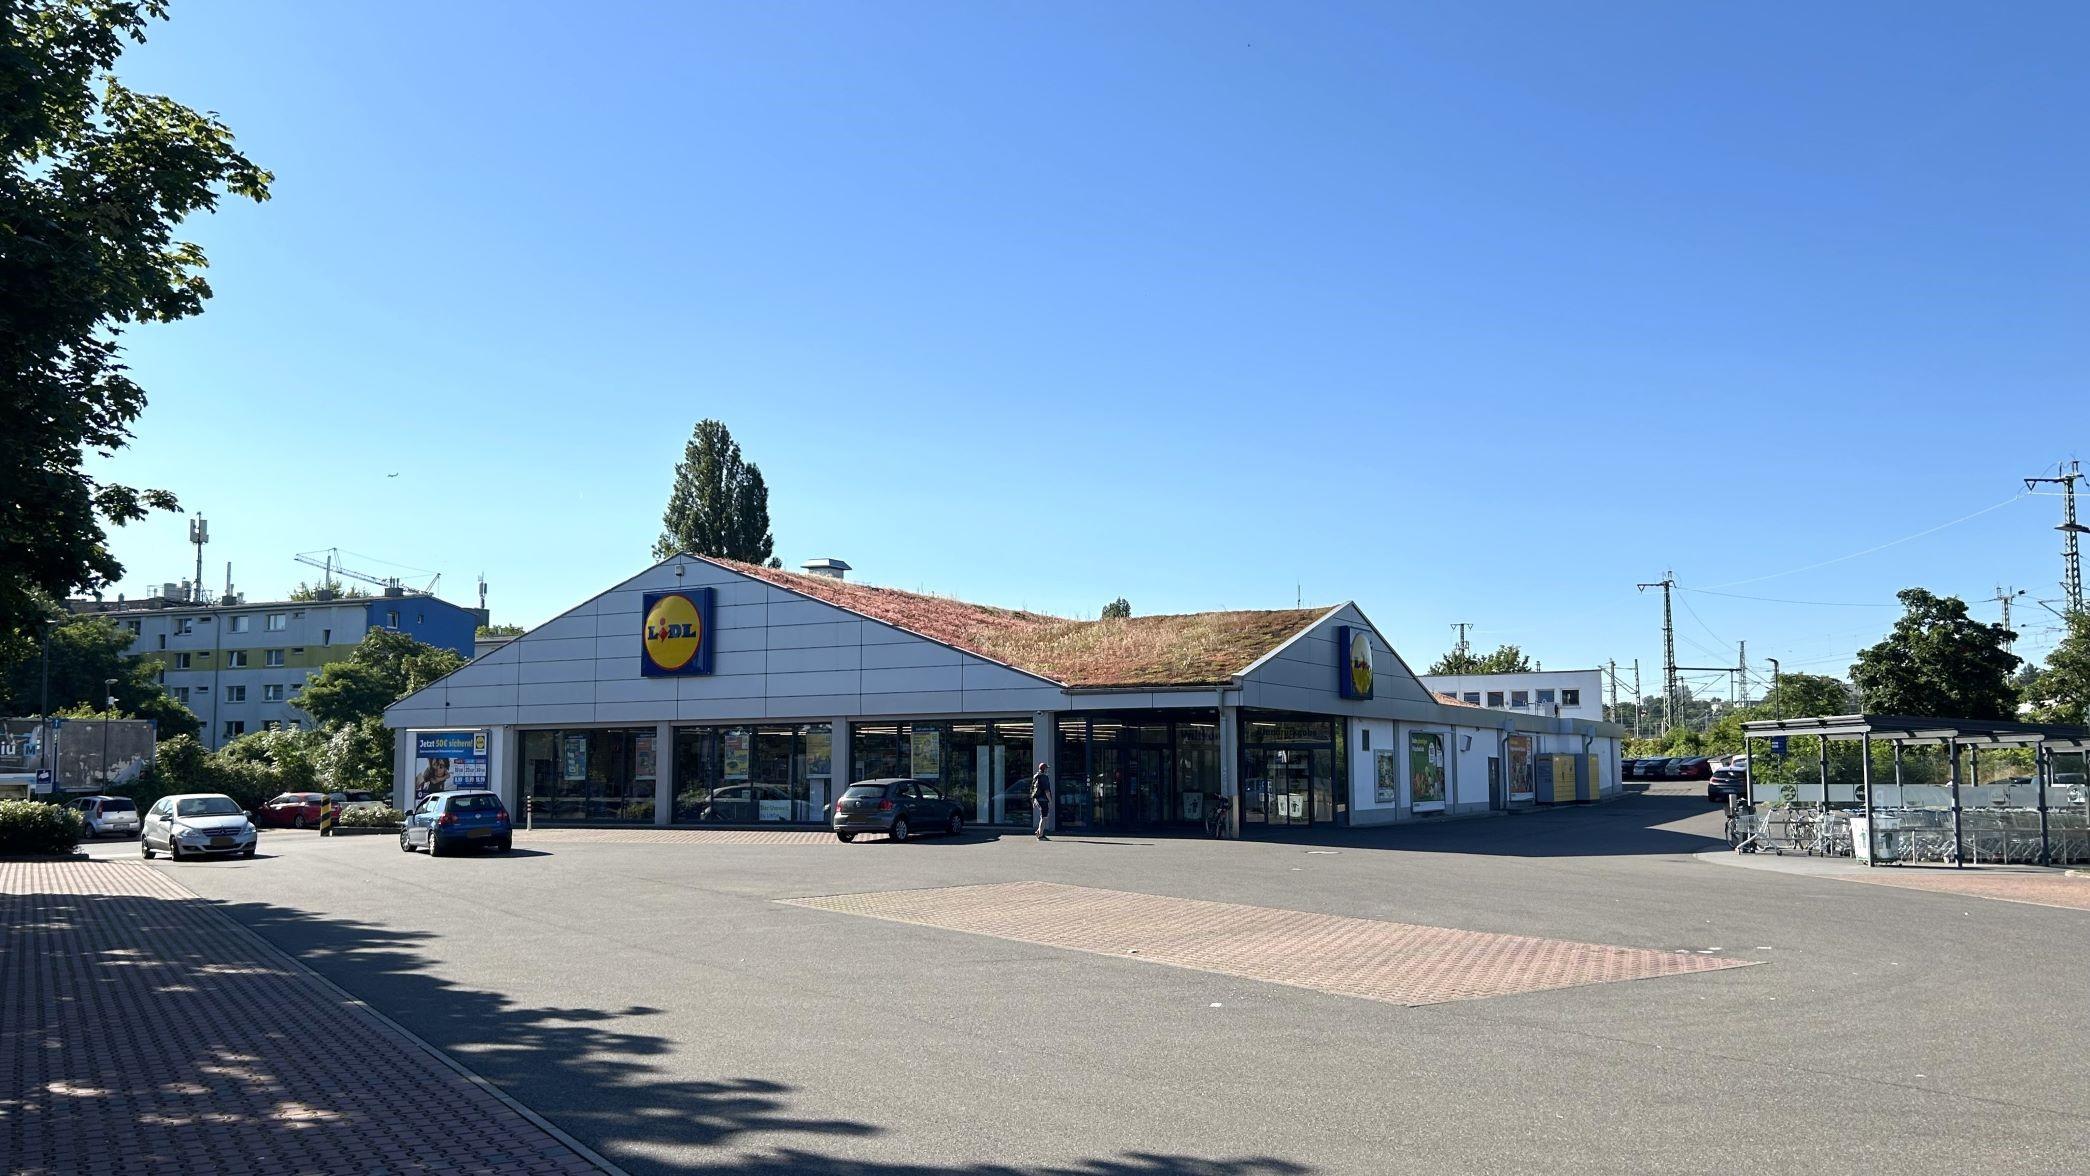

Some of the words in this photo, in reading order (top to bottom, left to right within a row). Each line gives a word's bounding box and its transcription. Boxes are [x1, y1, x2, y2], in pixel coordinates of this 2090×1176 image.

[420, 739, 435, 748] Jetzt
[436, 738, 448, 748] 50€
[449, 738, 473, 748] sichern!
